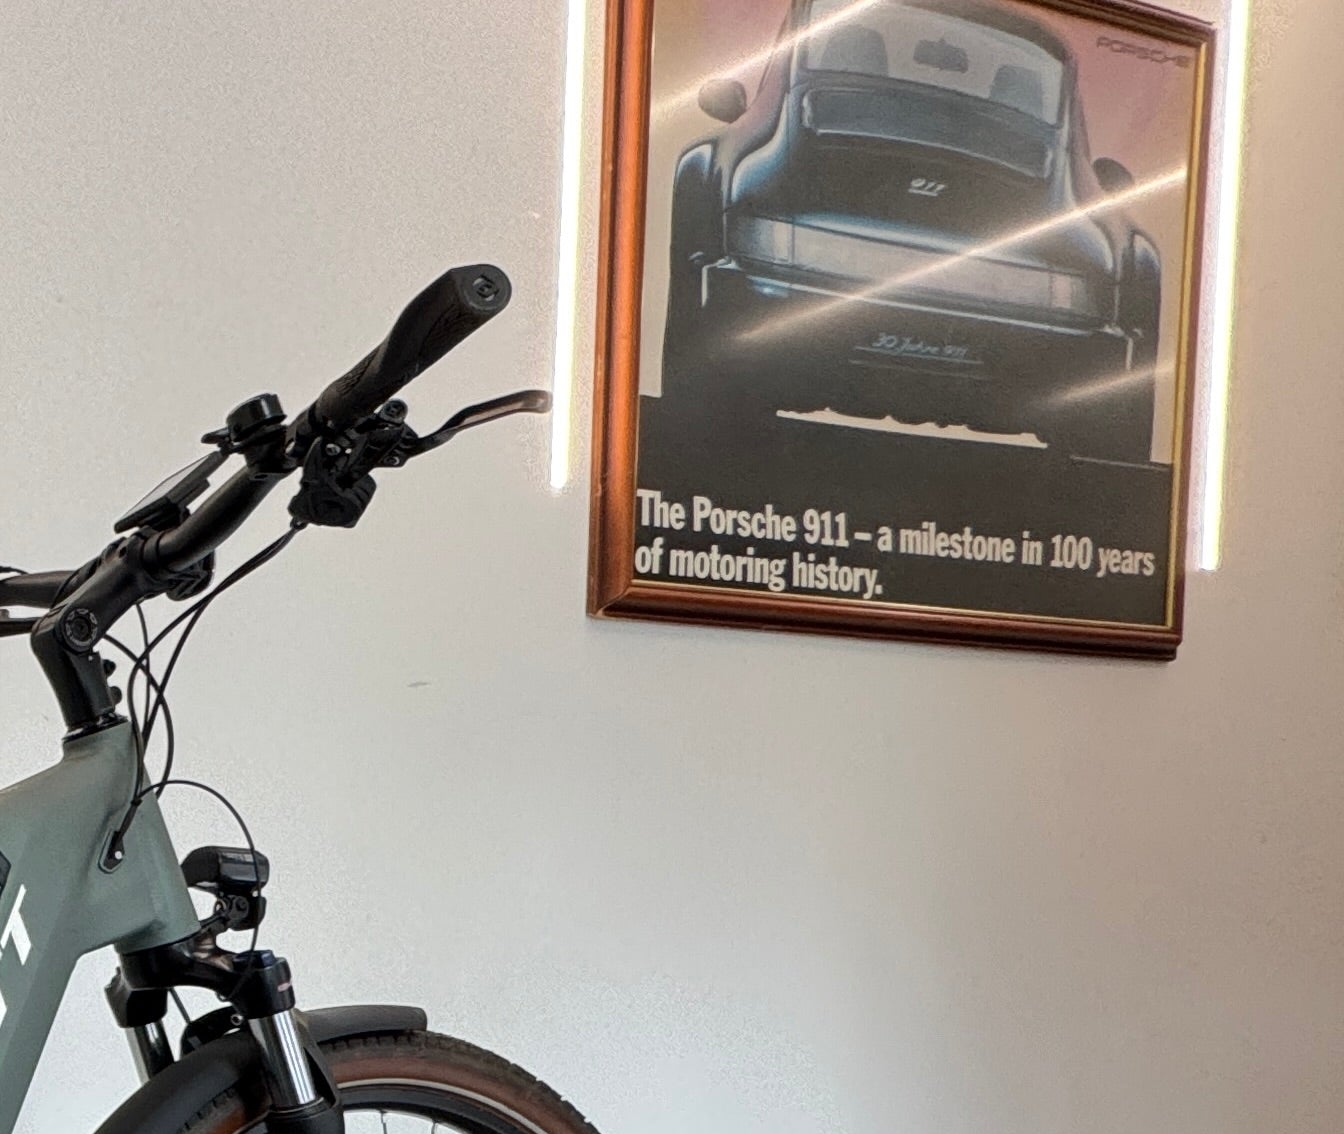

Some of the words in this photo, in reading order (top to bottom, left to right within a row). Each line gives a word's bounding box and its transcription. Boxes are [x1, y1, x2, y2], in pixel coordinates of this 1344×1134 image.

[1096, 36, 1191, 68] PORSCHE
[636, 488, 686, 530] The
[692, 496, 797, 542] Porsche
[803, 508, 849, 548] 911
[877, 526, 893, 551] a
[899, 521, 1015, 563] milestone
[1021, 530, 1043, 565] in
[1050, 535, 1093, 570] 100
[1096, 547, 1155, 578] years
[634, 537, 664, 574] of
[669, 545, 787, 592] motoring
[792, 552, 883, 599] history.
